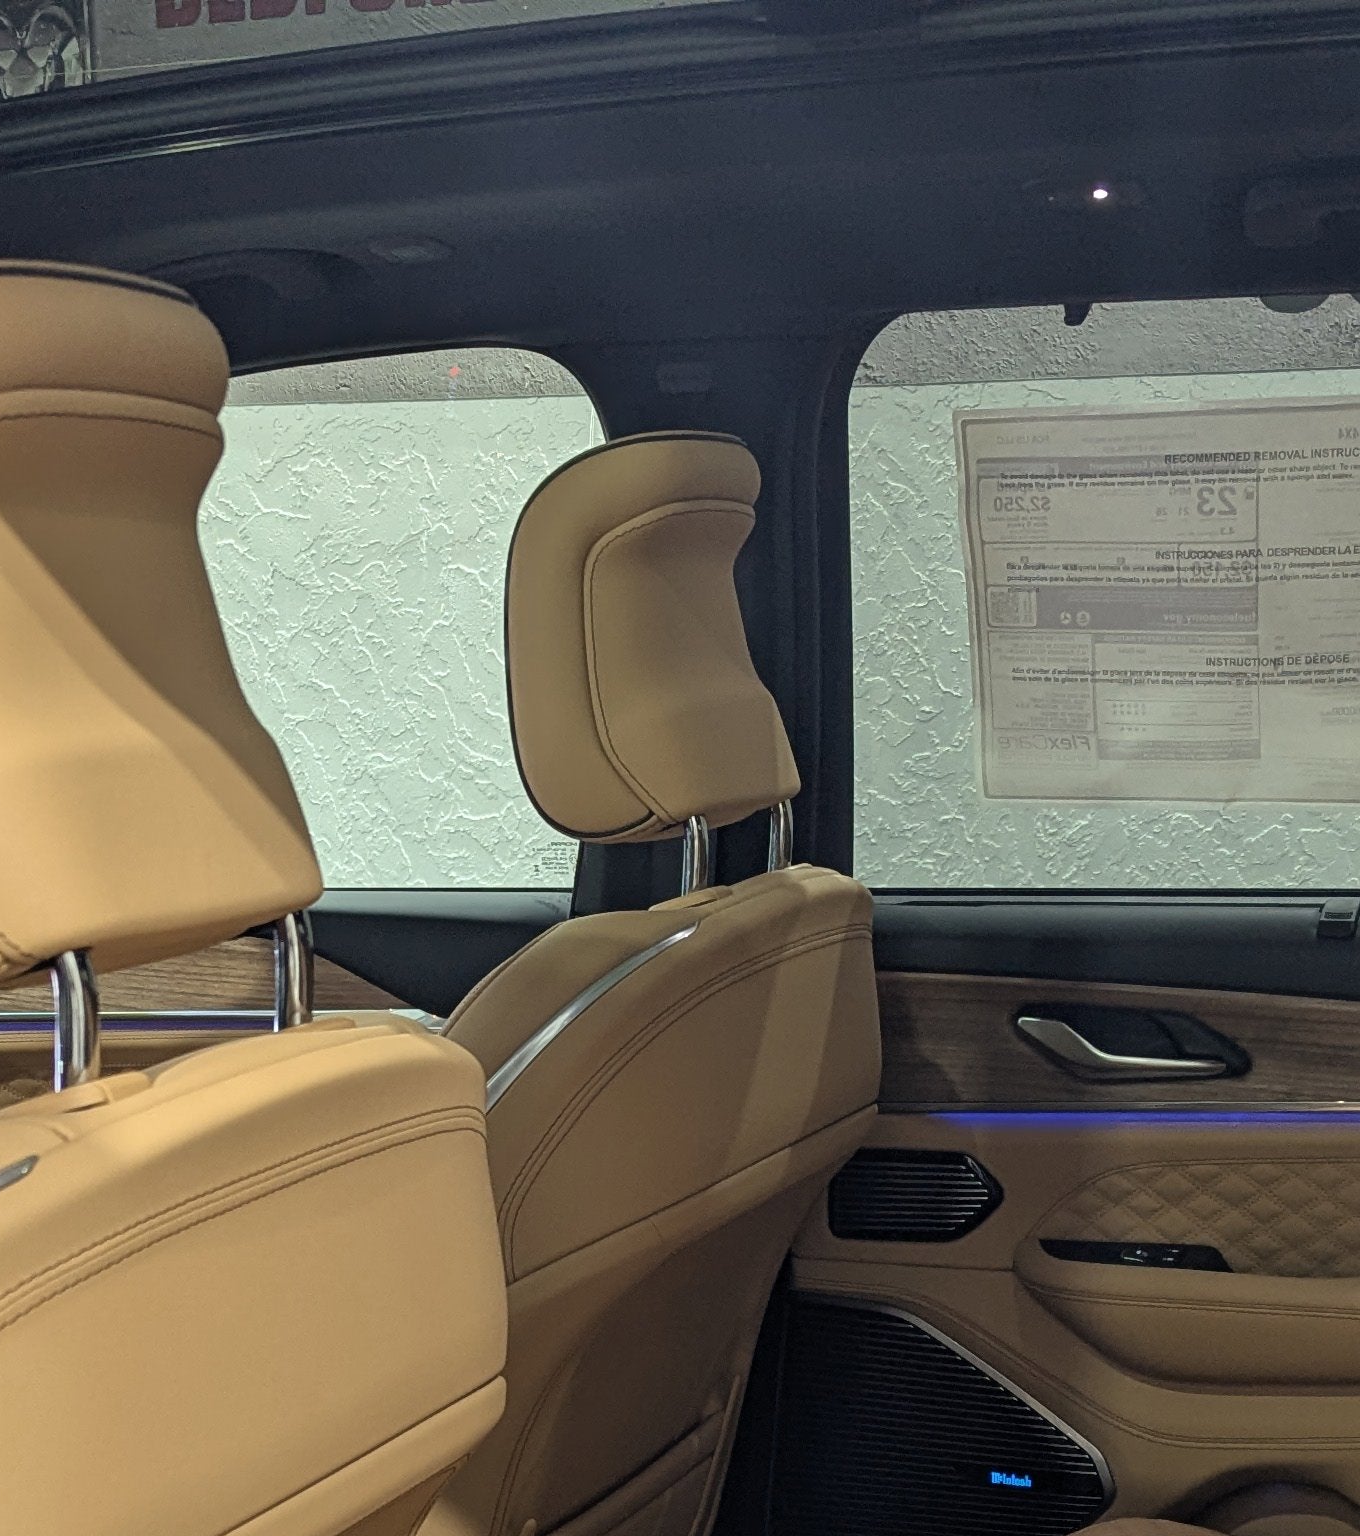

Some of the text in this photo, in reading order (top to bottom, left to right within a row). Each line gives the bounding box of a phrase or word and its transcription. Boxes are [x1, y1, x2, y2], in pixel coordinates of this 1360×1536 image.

[1164, 451, 1251, 464] RECOMMENDED
[1253, 448, 1309, 462] REMOVAL
[1156, 550, 1233, 560] INSTRUCCIONES
[1235, 548, 1263, 558] PARA
[1267, 546, 1336, 557] DESPRENDER
[1338, 545, 1353, 556] LA
[1206, 656, 1284, 667] INSTRUCTIONS
[1286, 655, 1302, 666] DE
